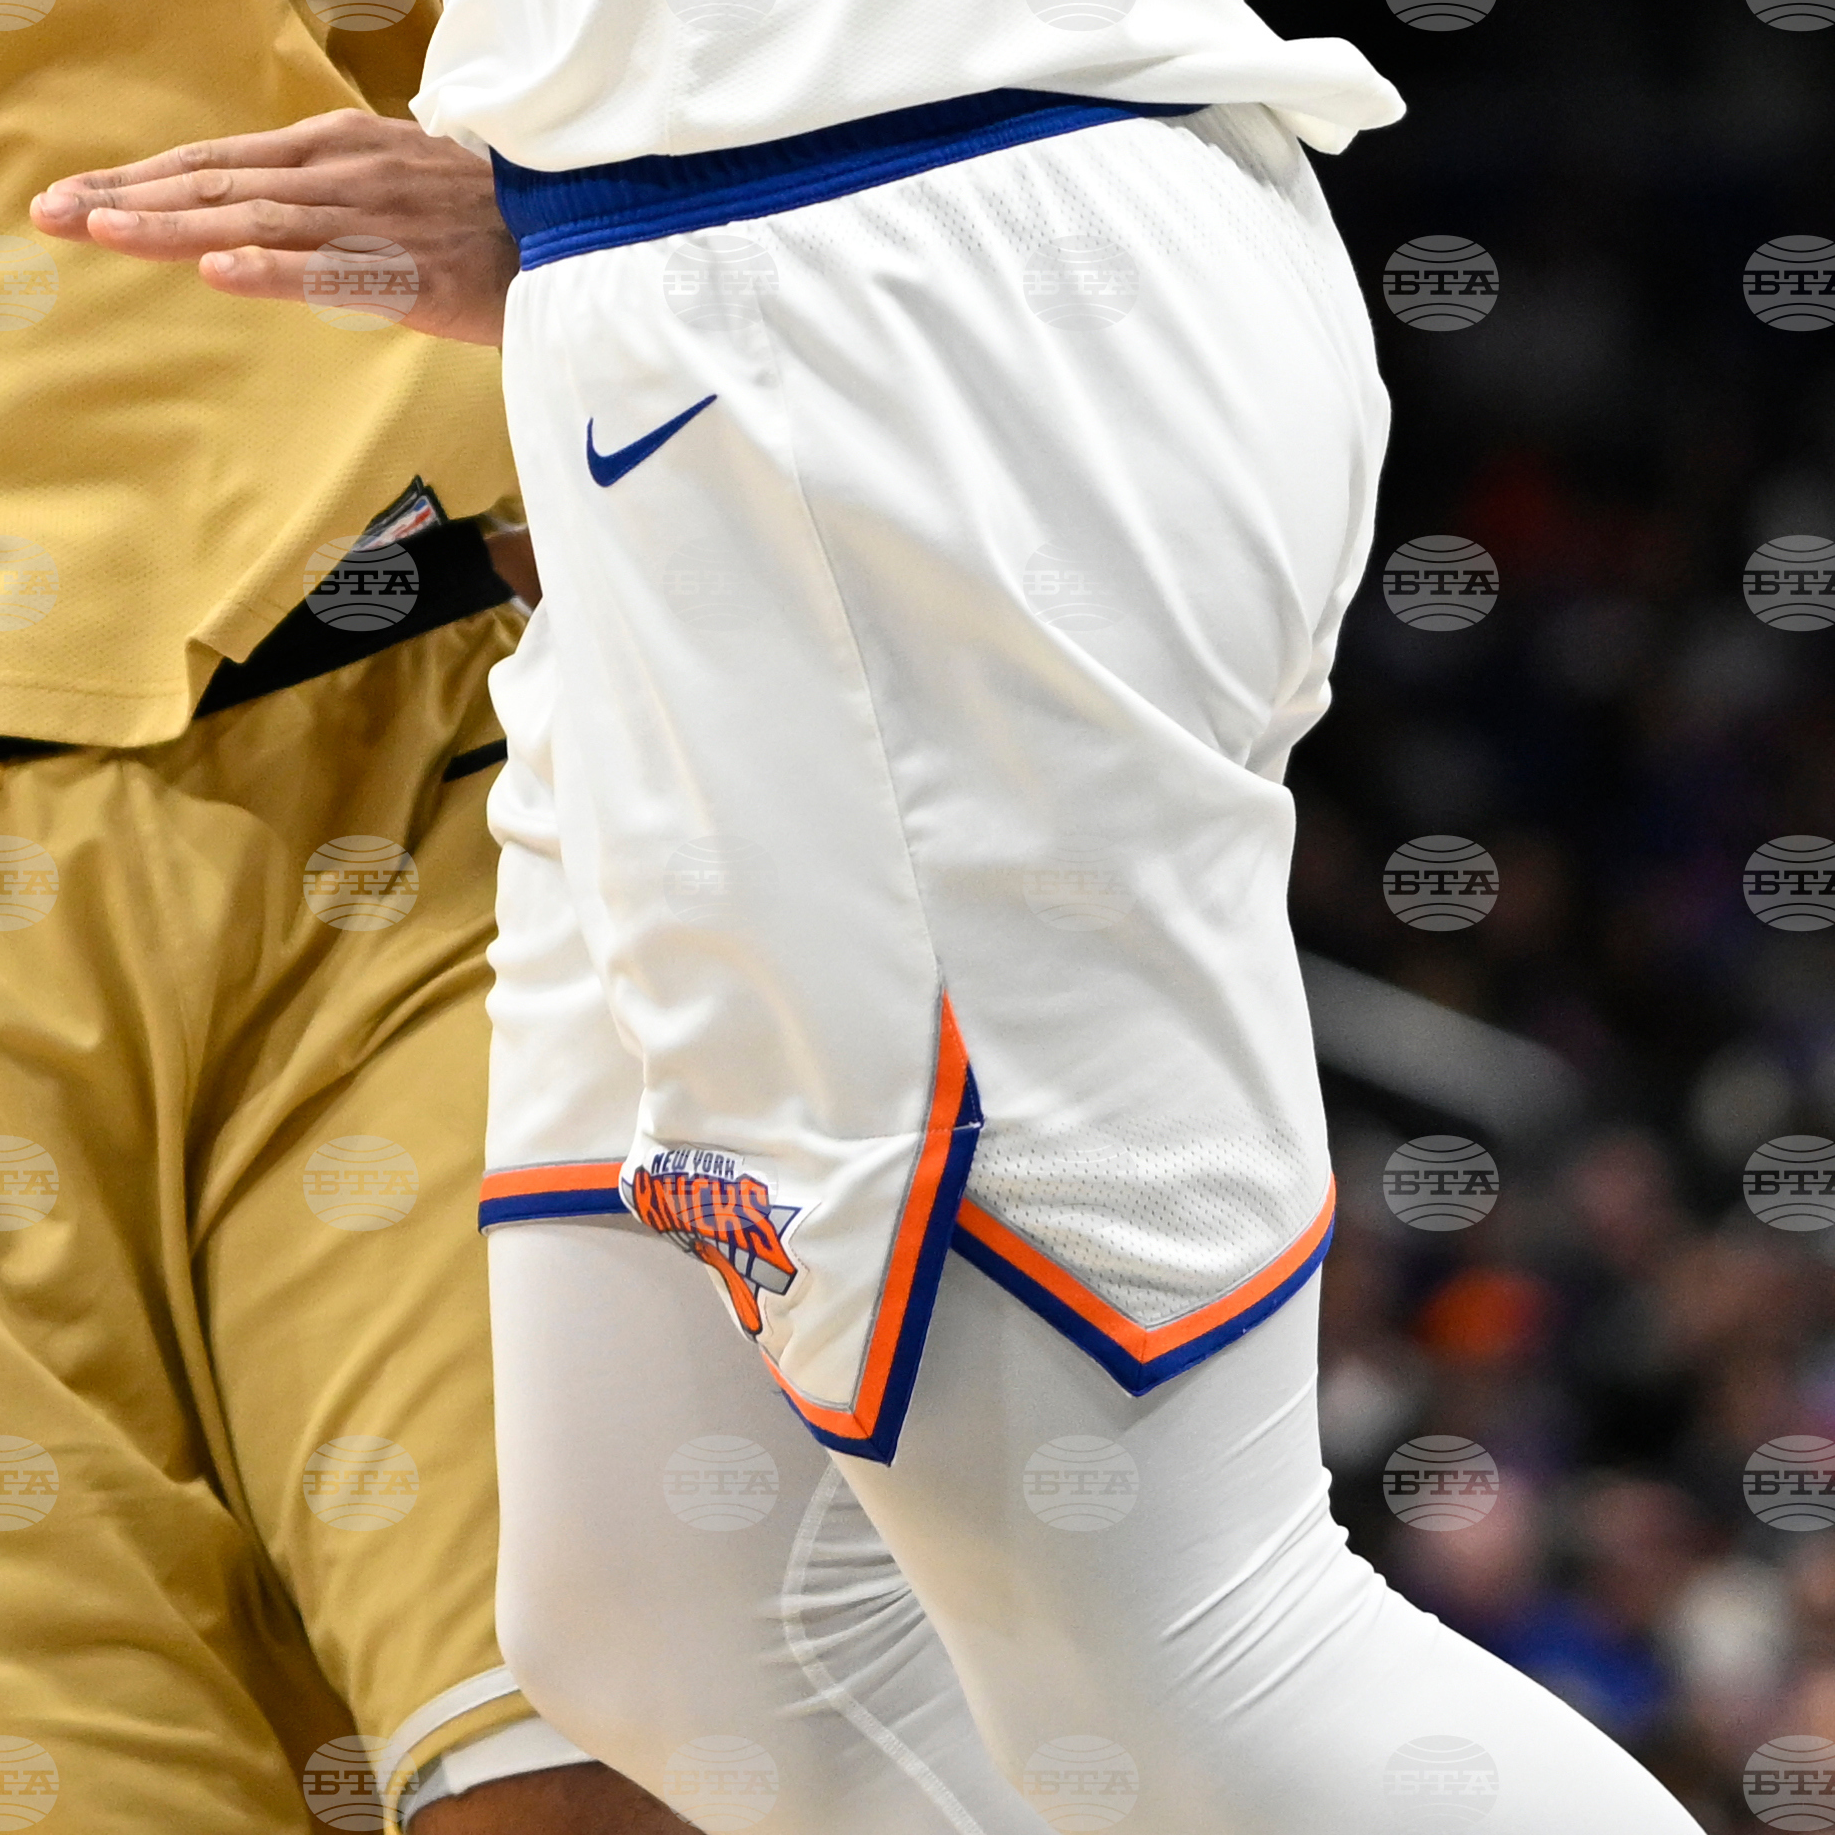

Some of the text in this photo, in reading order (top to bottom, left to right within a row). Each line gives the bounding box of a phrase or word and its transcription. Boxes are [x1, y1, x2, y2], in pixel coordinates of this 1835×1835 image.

[651, 1149, 735, 1179] NEW YORK
[633, 1169, 797, 1275] KNICKS
